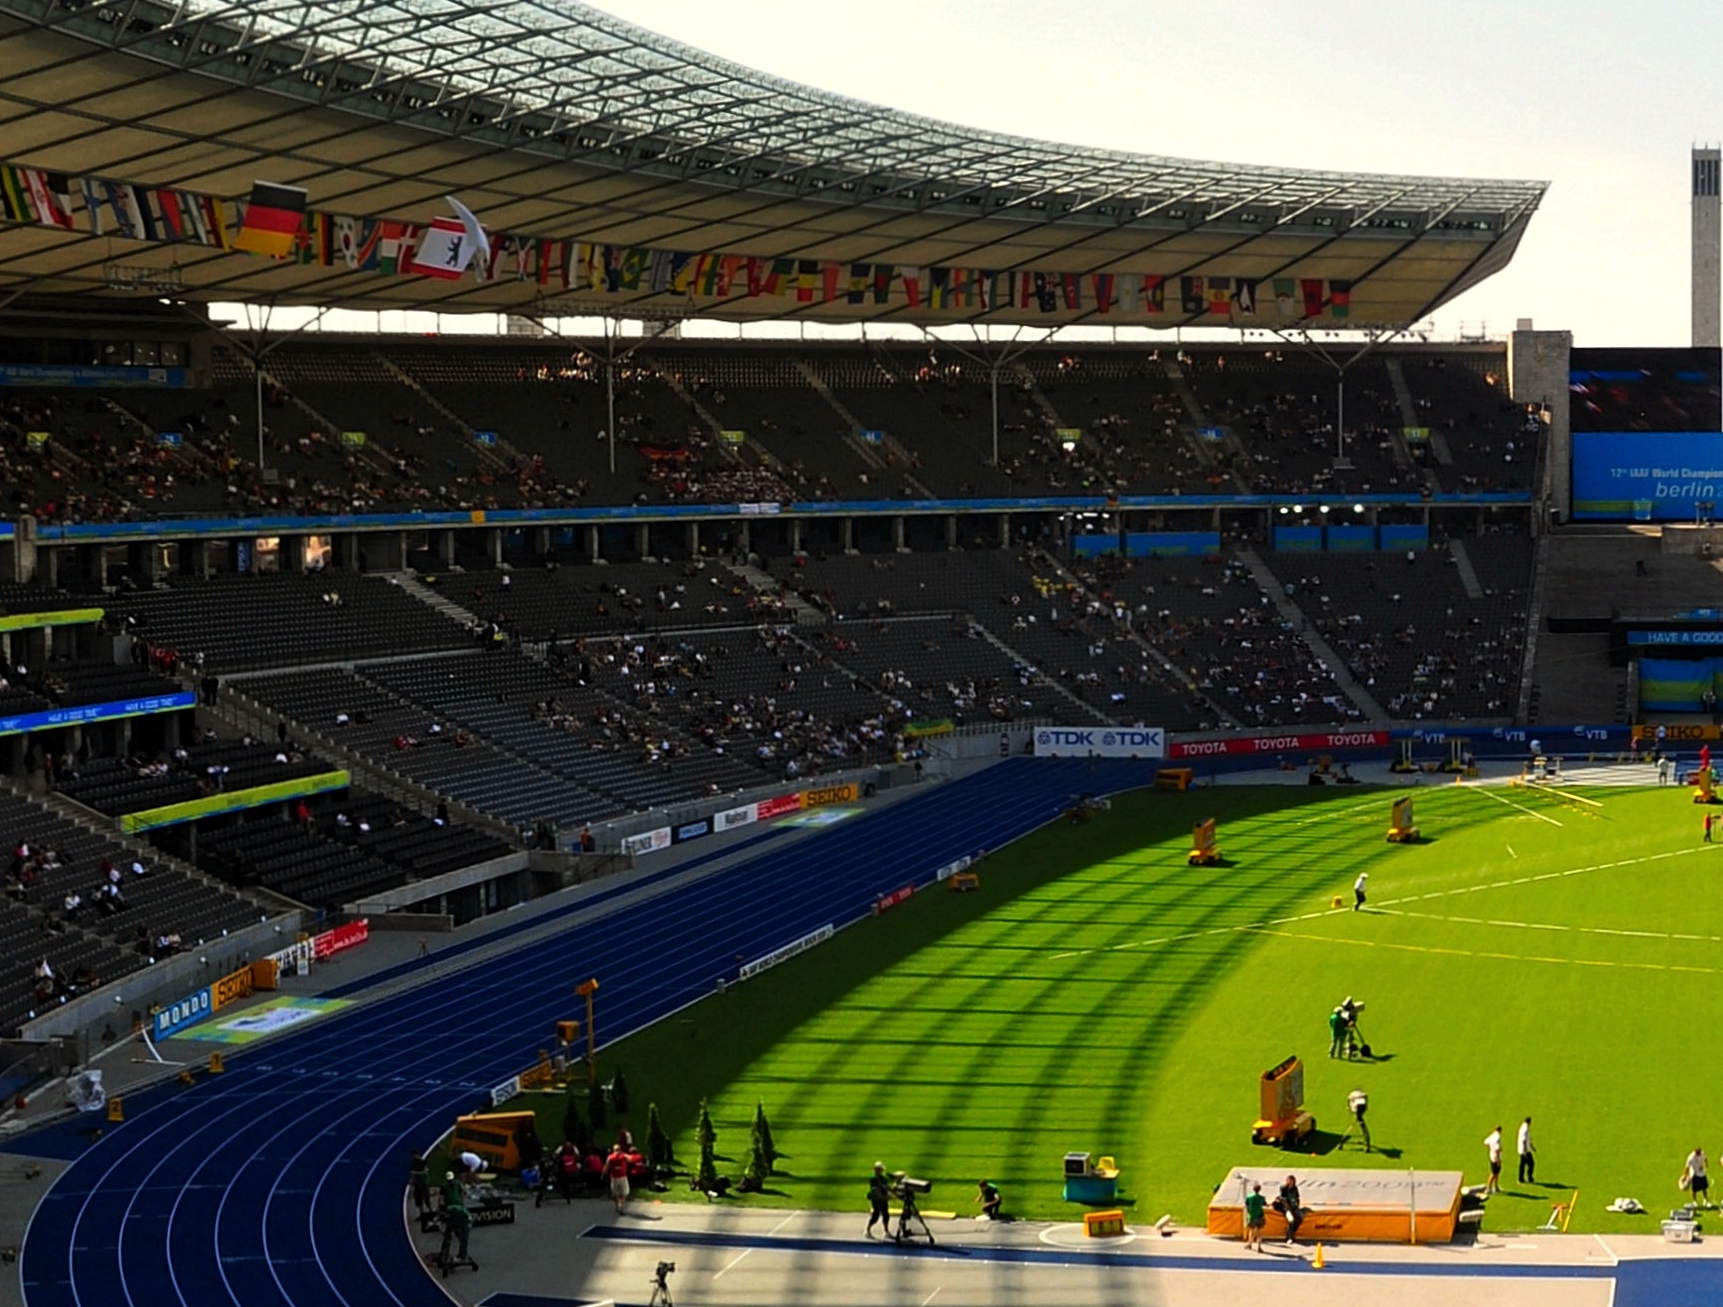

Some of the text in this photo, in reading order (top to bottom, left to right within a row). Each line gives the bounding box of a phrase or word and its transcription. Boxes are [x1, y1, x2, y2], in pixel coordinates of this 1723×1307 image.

[1629, 468, 1650, 478] IAAF
[1652, 468, 1679, 478] World
[1655, 482, 1715, 498] berlin
[1648, 631, 1678, 643] HAVE
[1682, 631, 1689, 643] A
[1050, 731, 1094, 745] TDK
[1115, 731, 1160, 746] TDK
[1505, 731, 1526, 742] VTB
[1586, 729, 1608, 740] VTB
[1641, 725, 1704, 740] SIKO
[1253, 737, 1300, 750] TOYOTA
[1328, 734, 1376, 746] TOYOTA
[1183, 742, 1227, 755] TOYOTA
[807, 785, 853, 808] SEIKO
[218, 968, 254, 1005] SEIKO
[159, 991, 208, 1030] MONDO
[111, 1100, 120, 1112] 2
